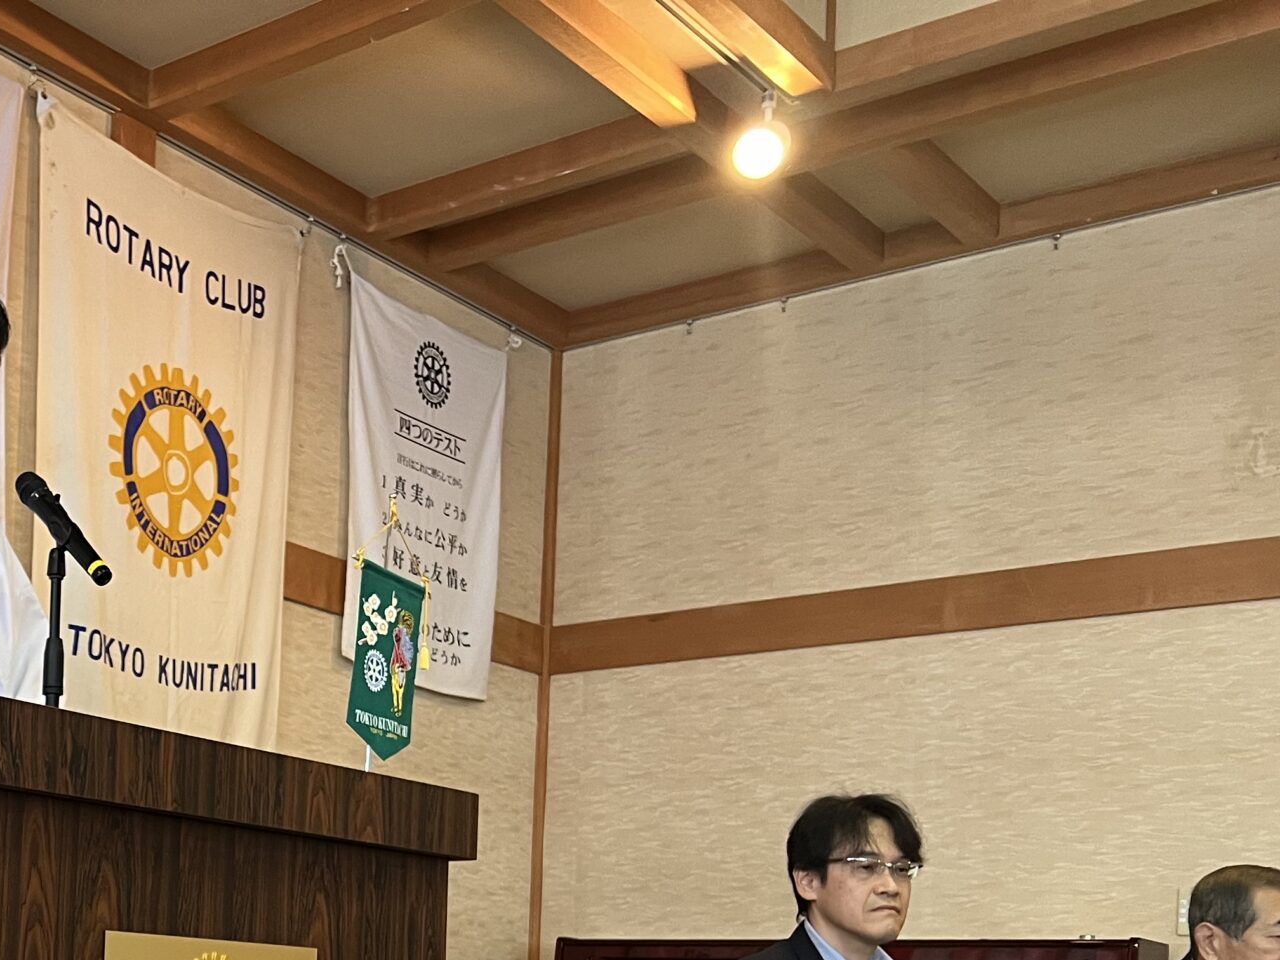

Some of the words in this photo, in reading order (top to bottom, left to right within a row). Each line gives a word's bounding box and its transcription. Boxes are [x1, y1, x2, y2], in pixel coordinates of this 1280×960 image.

[86, 197, 190, 294] ROTARY
[205, 270, 266, 319] CLUB
[153, 388, 202, 421] ROTARY
[399, 416, 461, 457] 四つのテスト
[128, 493, 224, 557] INTERNATIONAL
[394, 475, 434, 510] 真実か
[443, 502, 467, 523] どうか
[67, 623, 145, 678] TOKYO
[158, 654, 257, 692] KUNITACHI
